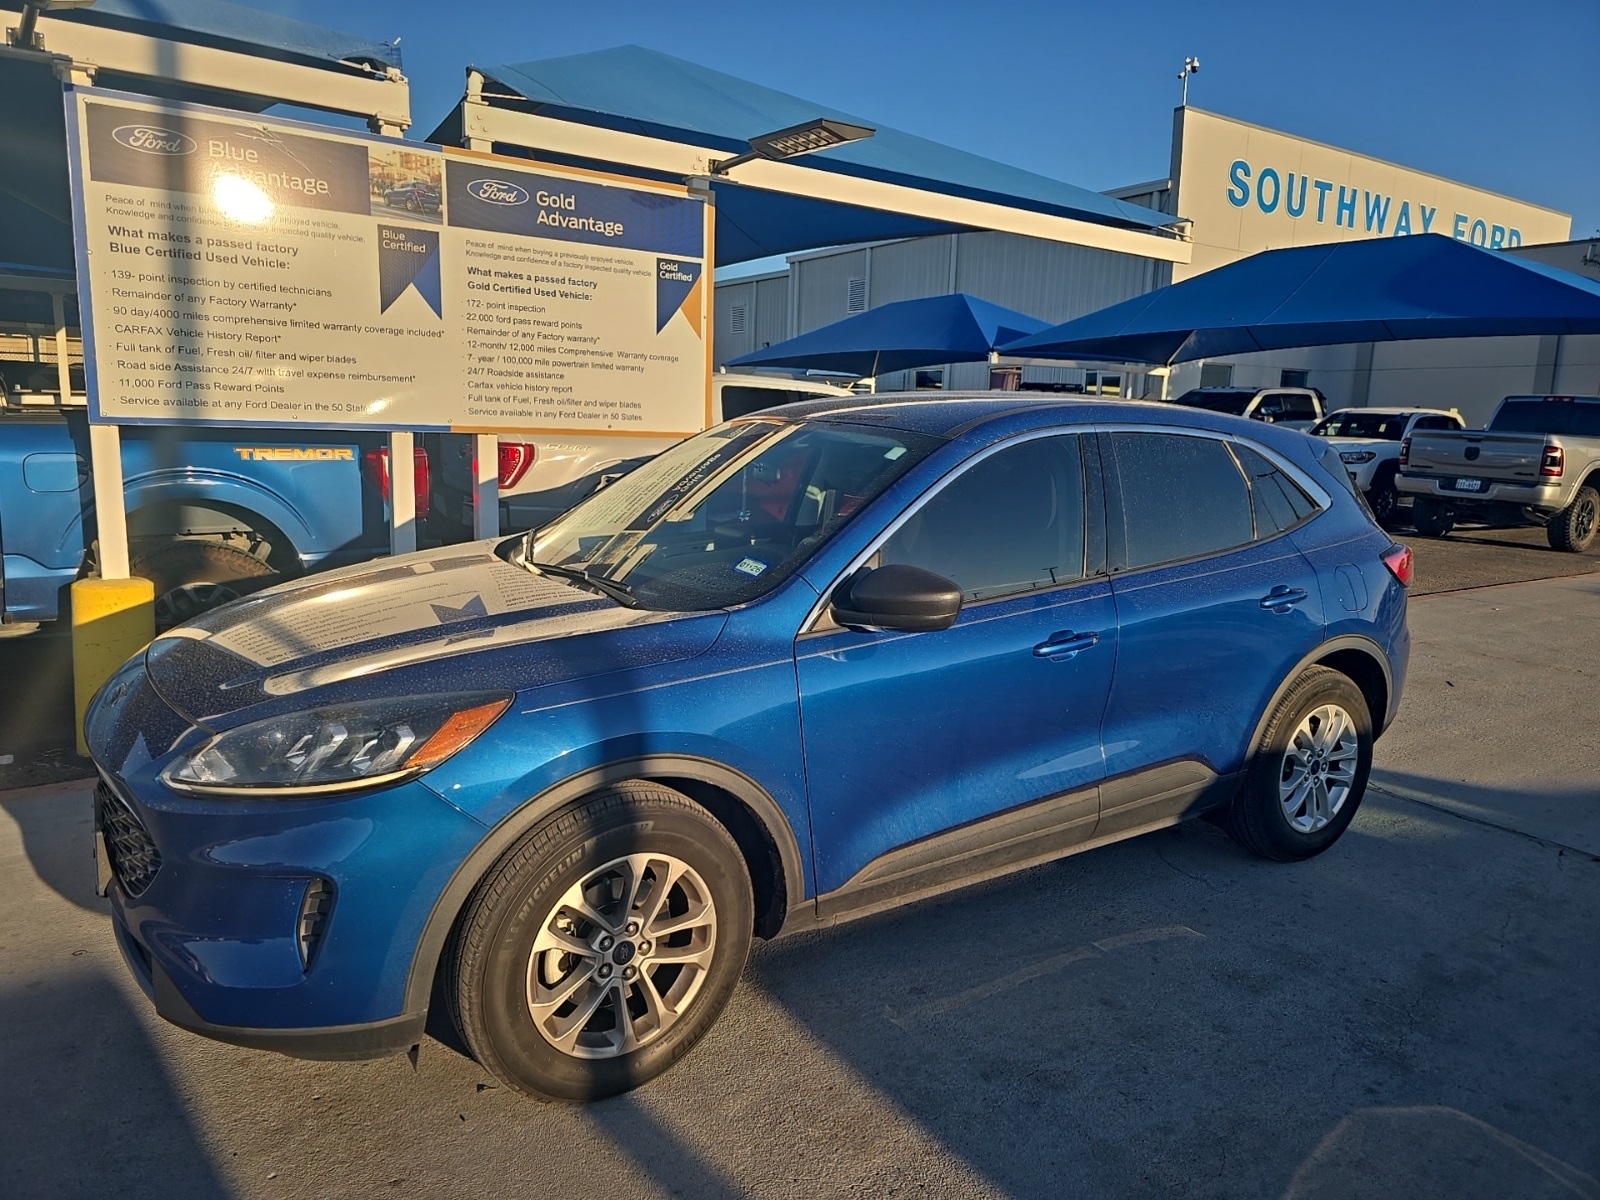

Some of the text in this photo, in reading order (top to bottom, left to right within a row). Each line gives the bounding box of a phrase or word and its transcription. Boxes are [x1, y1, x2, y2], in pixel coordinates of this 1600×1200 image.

[129, 128, 180, 152] Ford
[209, 140, 258, 163] Blue
[479, 182, 517, 203] Ford
[536, 190, 575, 210] Gold
[105, 194, 197, 213] Peace of mind when
[1226, 158, 1522, 249] SOUTHWAY FORD
[536, 210, 624, 237] Advantage
[108, 225, 298, 257] What makes a passed factory
[382, 230, 405, 240] Blue
[110, 242, 290, 269] Blue Certified Used Vehicle:
[382, 240, 426, 253] Certified
[660, 262, 678, 271] Gold
[660, 271, 692, 281] Certified
[139, 273, 165, 283] point
[168, 274, 220, 287] inspection
[223, 279, 236, 291] by
[238, 282, 277, 292] certified
[280, 285, 332, 297] technicians
[467, 266, 598, 290] What makes passed factory
[112, 287, 172, 301] Remainder
[187, 296, 206, 306] any
[209, 295, 247, 309] Factory
[467, 280, 592, 301] Gold Certified Used Vehicle:
[486, 302, 506, 310] point
[508, 302, 546, 313] inspection
[113, 306, 127, 315] 90
[130, 307, 180, 319] day/4000
[182, 312, 210, 322] miles
[212, 315, 287, 327] comprehensive
[290, 319, 320, 329] limited
[322, 323, 362, 334] warranty
[364, 326, 404, 337] coverage
[466, 312, 583, 330] 22,000 ford pass reward points
[115, 324, 163, 335] CARFAX
[166, 327, 204, 338] Vehicle
[207, 330, 242, 343] History
[467, 326, 510, 337] Remainder
[521, 332, 535, 341] any
[537, 331, 565, 343] Factory
[116, 342, 136, 352] Full
[139, 344, 162, 353] tank
[178, 345, 204, 356] Fuel,
[207, 347, 236, 357] Fresh
[255, 350, 276, 359] filter
[279, 353, 297, 361] and
[299, 353, 324, 363] wiper
[326, 355, 357, 364] blades
[509, 343, 535, 352] 12,000
[537, 345, 557, 354] miles
[558, 346, 614, 358] Comprehensive
[617, 351, 648, 362] Warranty
[649, 354, 679, 363] coverage
[117, 360, 146, 370] Road
[149, 362, 171, 371] side
[174, 363, 229, 374] Assistance
[232, 366, 253, 375] 24/7
[256, 367, 276, 376] with
[278, 368, 304, 378] travel
[307, 371, 346, 380] expense
[467, 367, 565, 380] 24/7 Roadside assistance
[477, 356, 645, 374] year 100,000 mile powertrain limited warranty
[119, 378, 285, 393] 11,000 Ford Pass Reward Points
[467, 380, 573, 394] Carfax vehicle history report
[120, 396, 370, 412] Service available at any Ford Dealer in the 50 Stat
[468, 393, 483, 402] Full
[484, 395, 501, 403] tank
[513, 395, 532, 405] Fuel,
[533, 396, 555, 405] Fresh
[584, 399, 598, 407] and
[598, 400, 618, 409] wiper
[619, 401, 642, 409] blades
[468, 407, 498, 416] Service
[499, 409, 533, 417] available
[543, 411, 557, 420] any
[559, 410, 576, 418] Ford
[577, 411, 601, 419] Dealer
[610, 412, 619, 420] 50
[621, 413, 642, 421] States
[234, 447, 355, 460] TREMOR
[518, 848, 582, 922] MICHELIN
